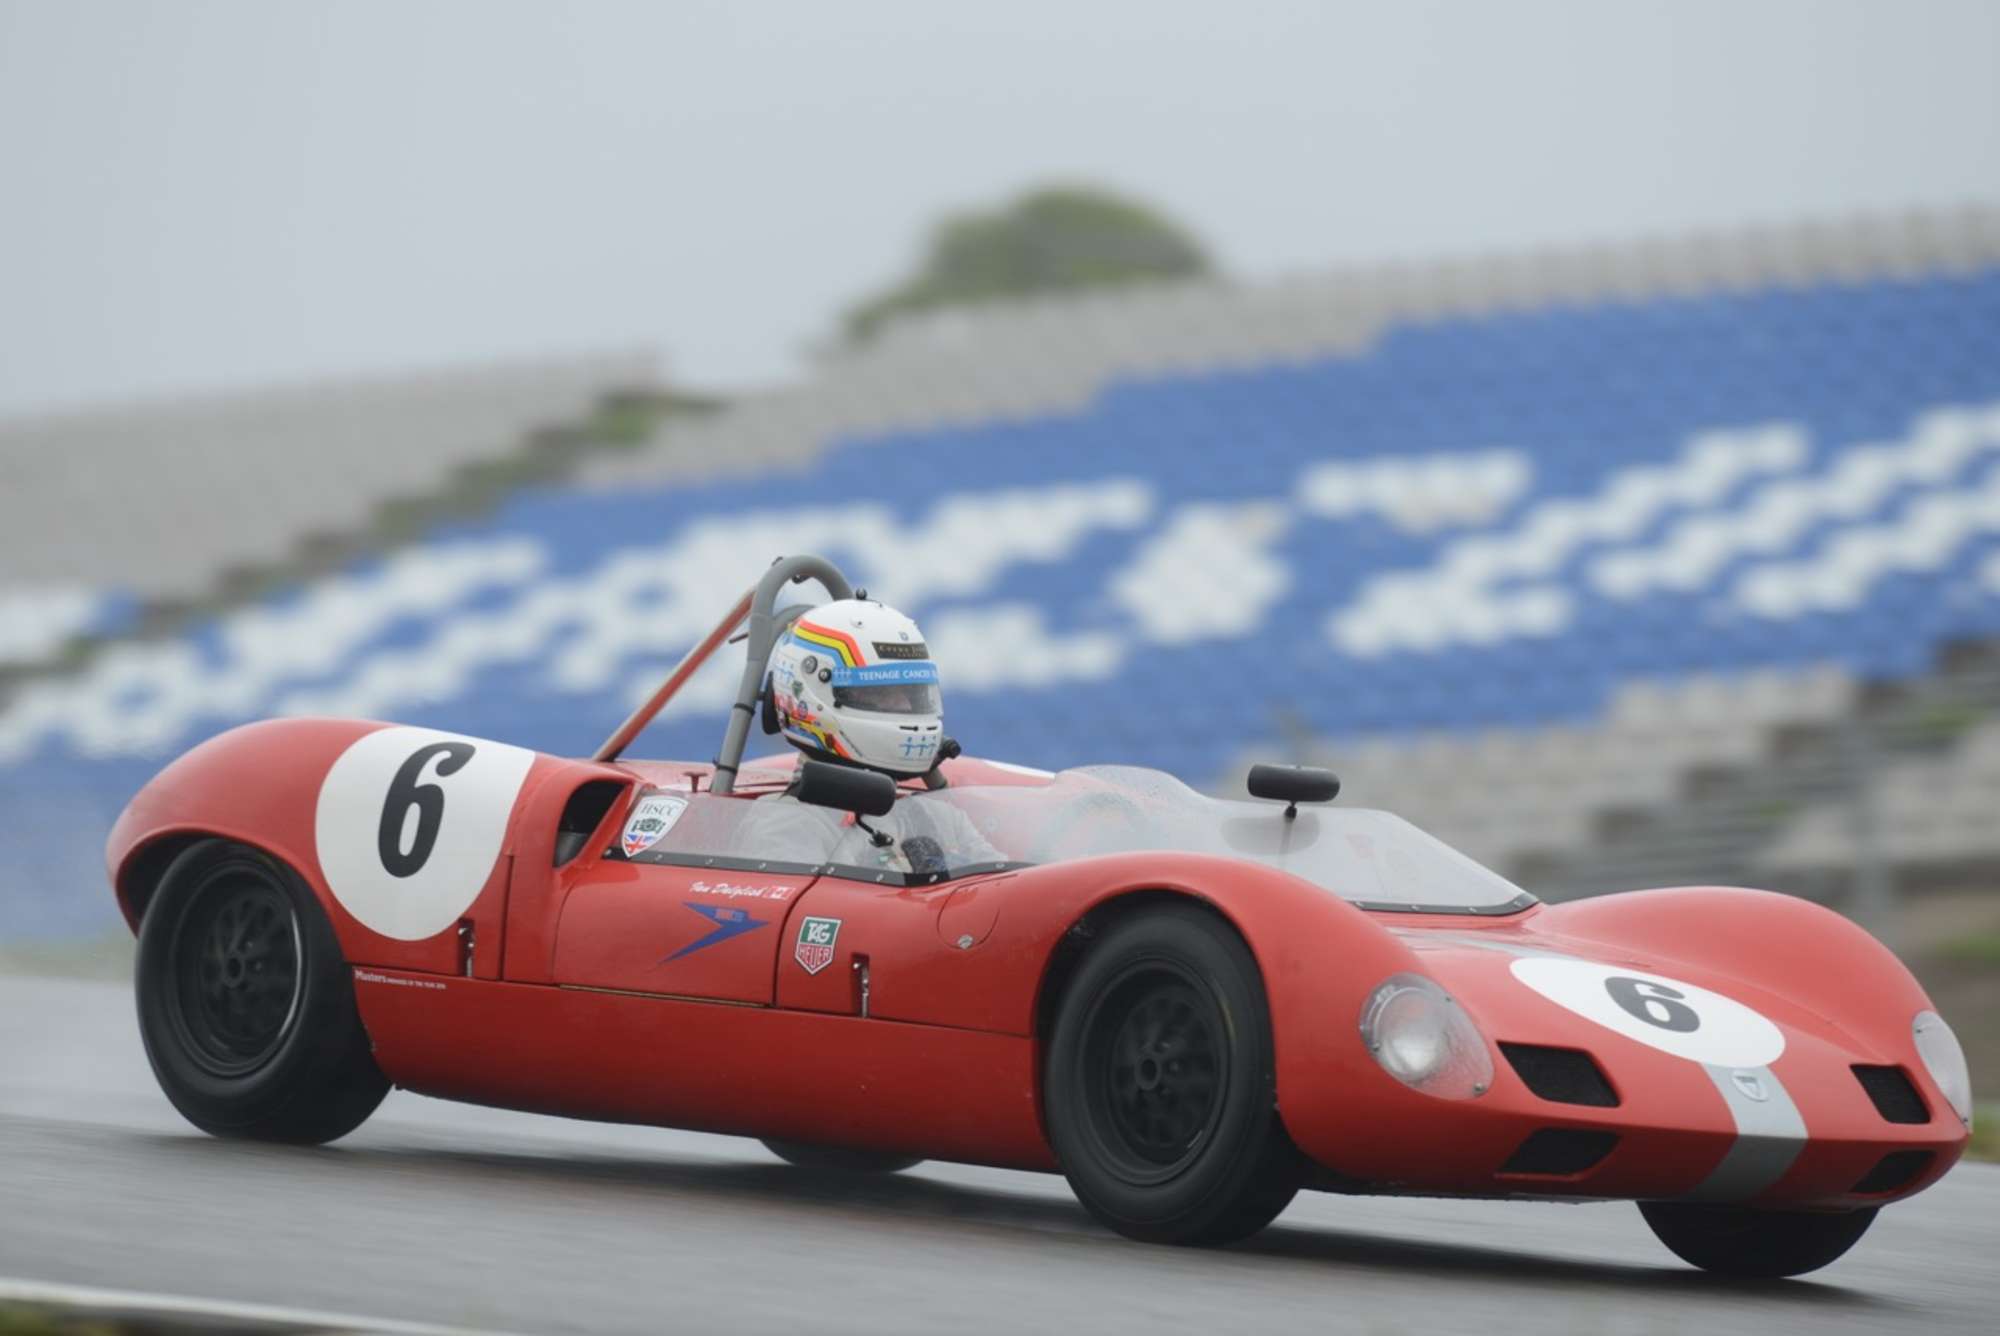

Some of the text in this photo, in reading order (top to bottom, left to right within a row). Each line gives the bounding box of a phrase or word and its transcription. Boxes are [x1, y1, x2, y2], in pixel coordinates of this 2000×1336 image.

[858, 670, 900, 681] TEENAGE
[377, 741, 477, 879] 6
[807, 922, 831, 943] TAG
[799, 946, 831, 969] HEUER
[1604, 976, 1701, 1034] 6
